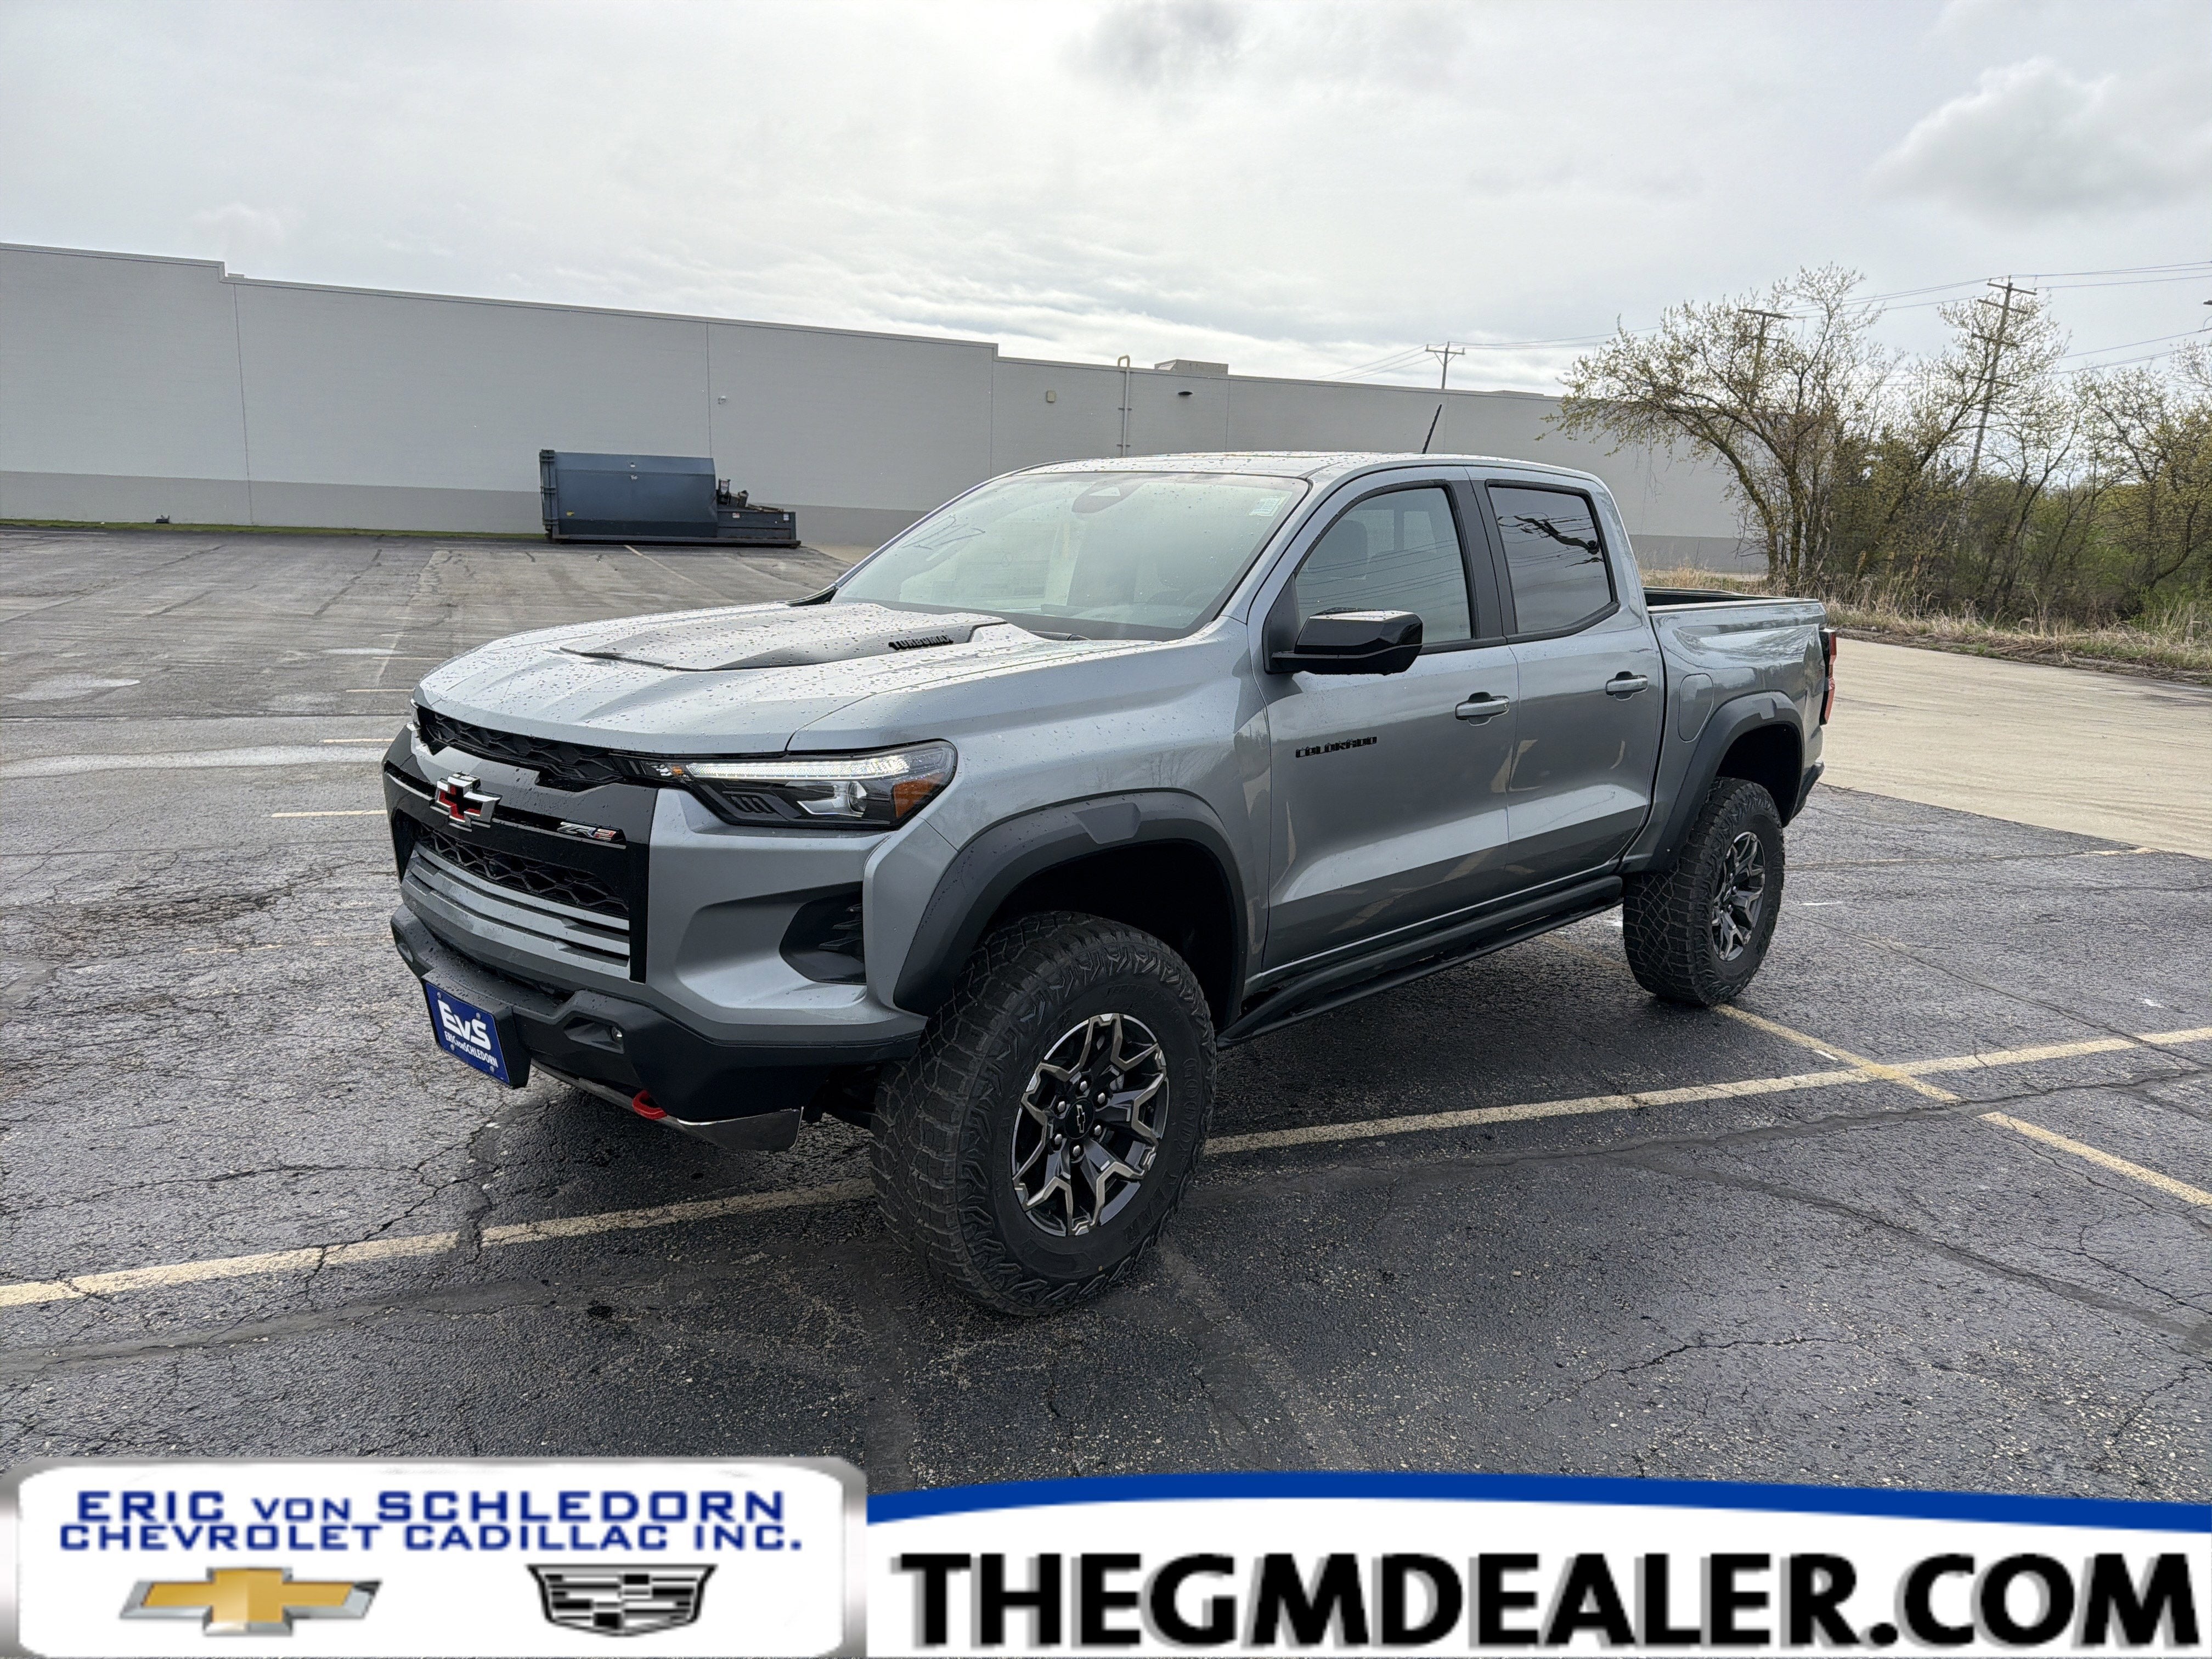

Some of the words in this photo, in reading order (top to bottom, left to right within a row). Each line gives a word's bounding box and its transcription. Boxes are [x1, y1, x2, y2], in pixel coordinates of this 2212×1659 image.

[889, 635, 953, 651] TURBOMAX
[1295, 736, 1378, 758] COLORADO
[556, 821, 617, 842] ZR2
